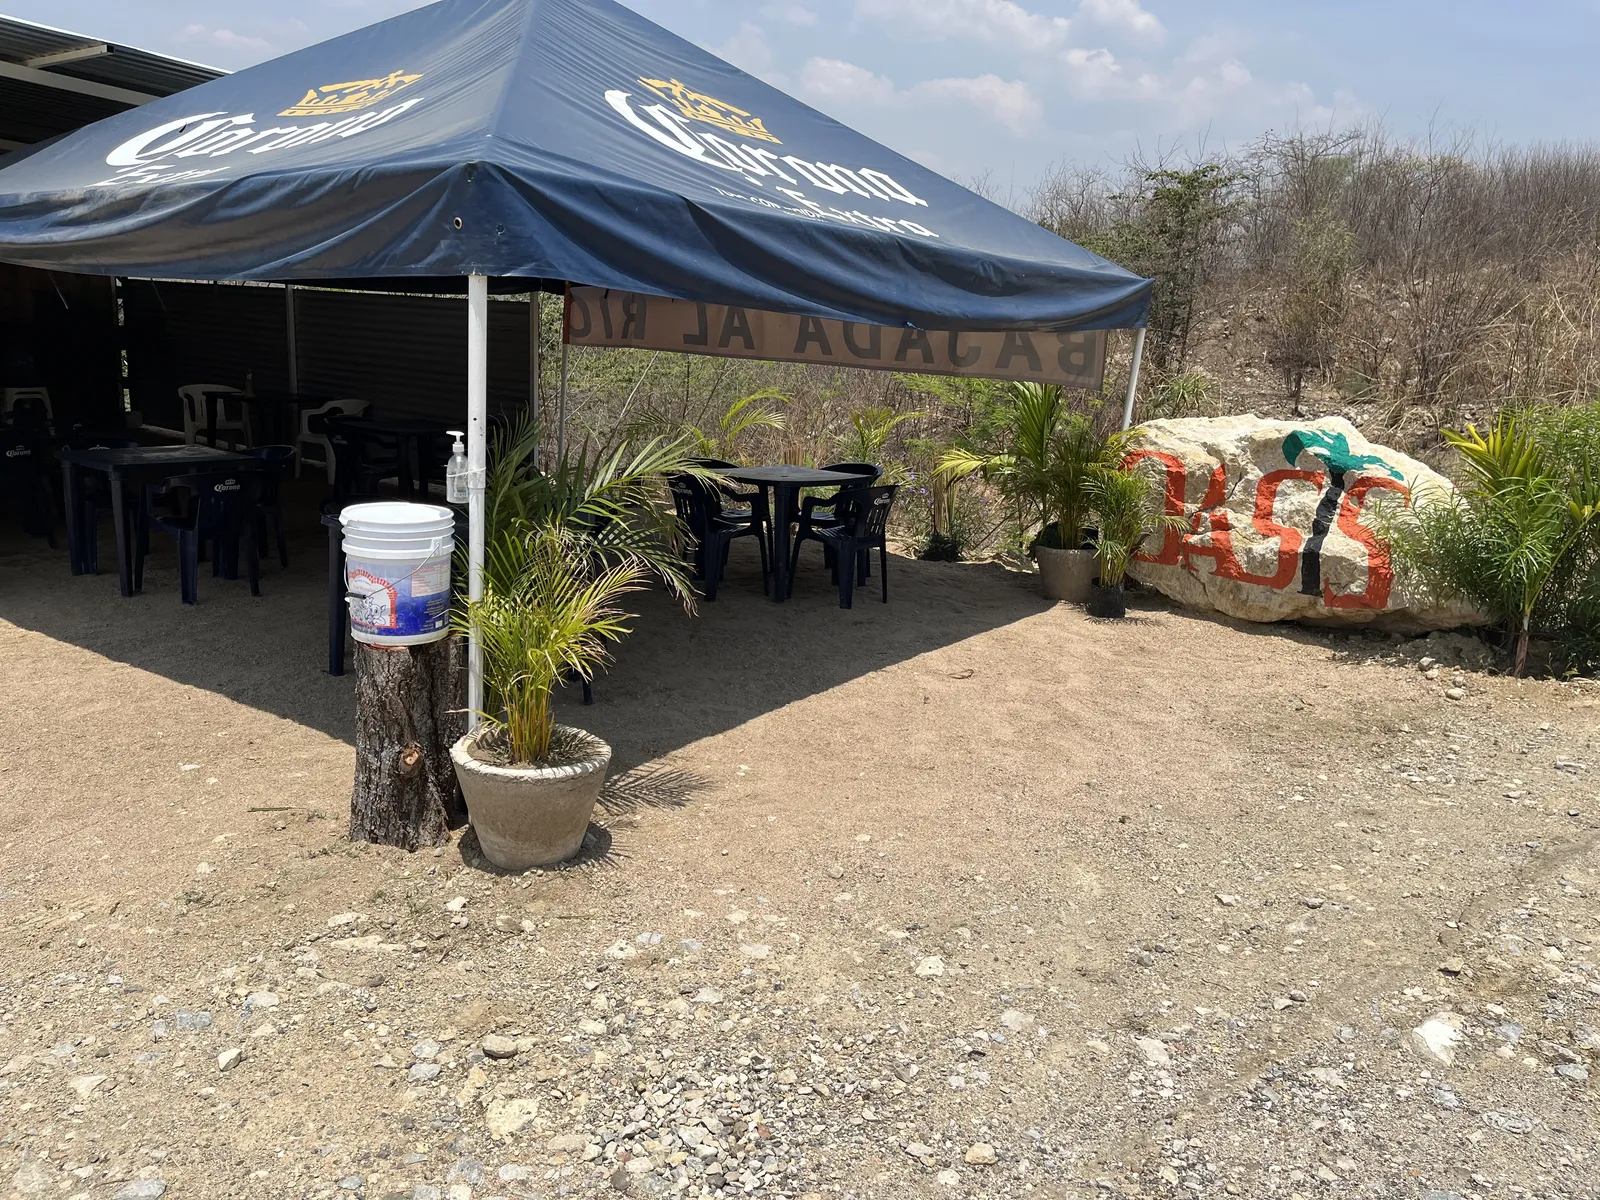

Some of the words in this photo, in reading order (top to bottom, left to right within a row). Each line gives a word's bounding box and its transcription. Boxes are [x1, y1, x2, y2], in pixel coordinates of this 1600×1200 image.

[106, 98, 424, 166] Corona
[605, 90, 928, 207] Corona
[776, 186, 939, 237] Extra
